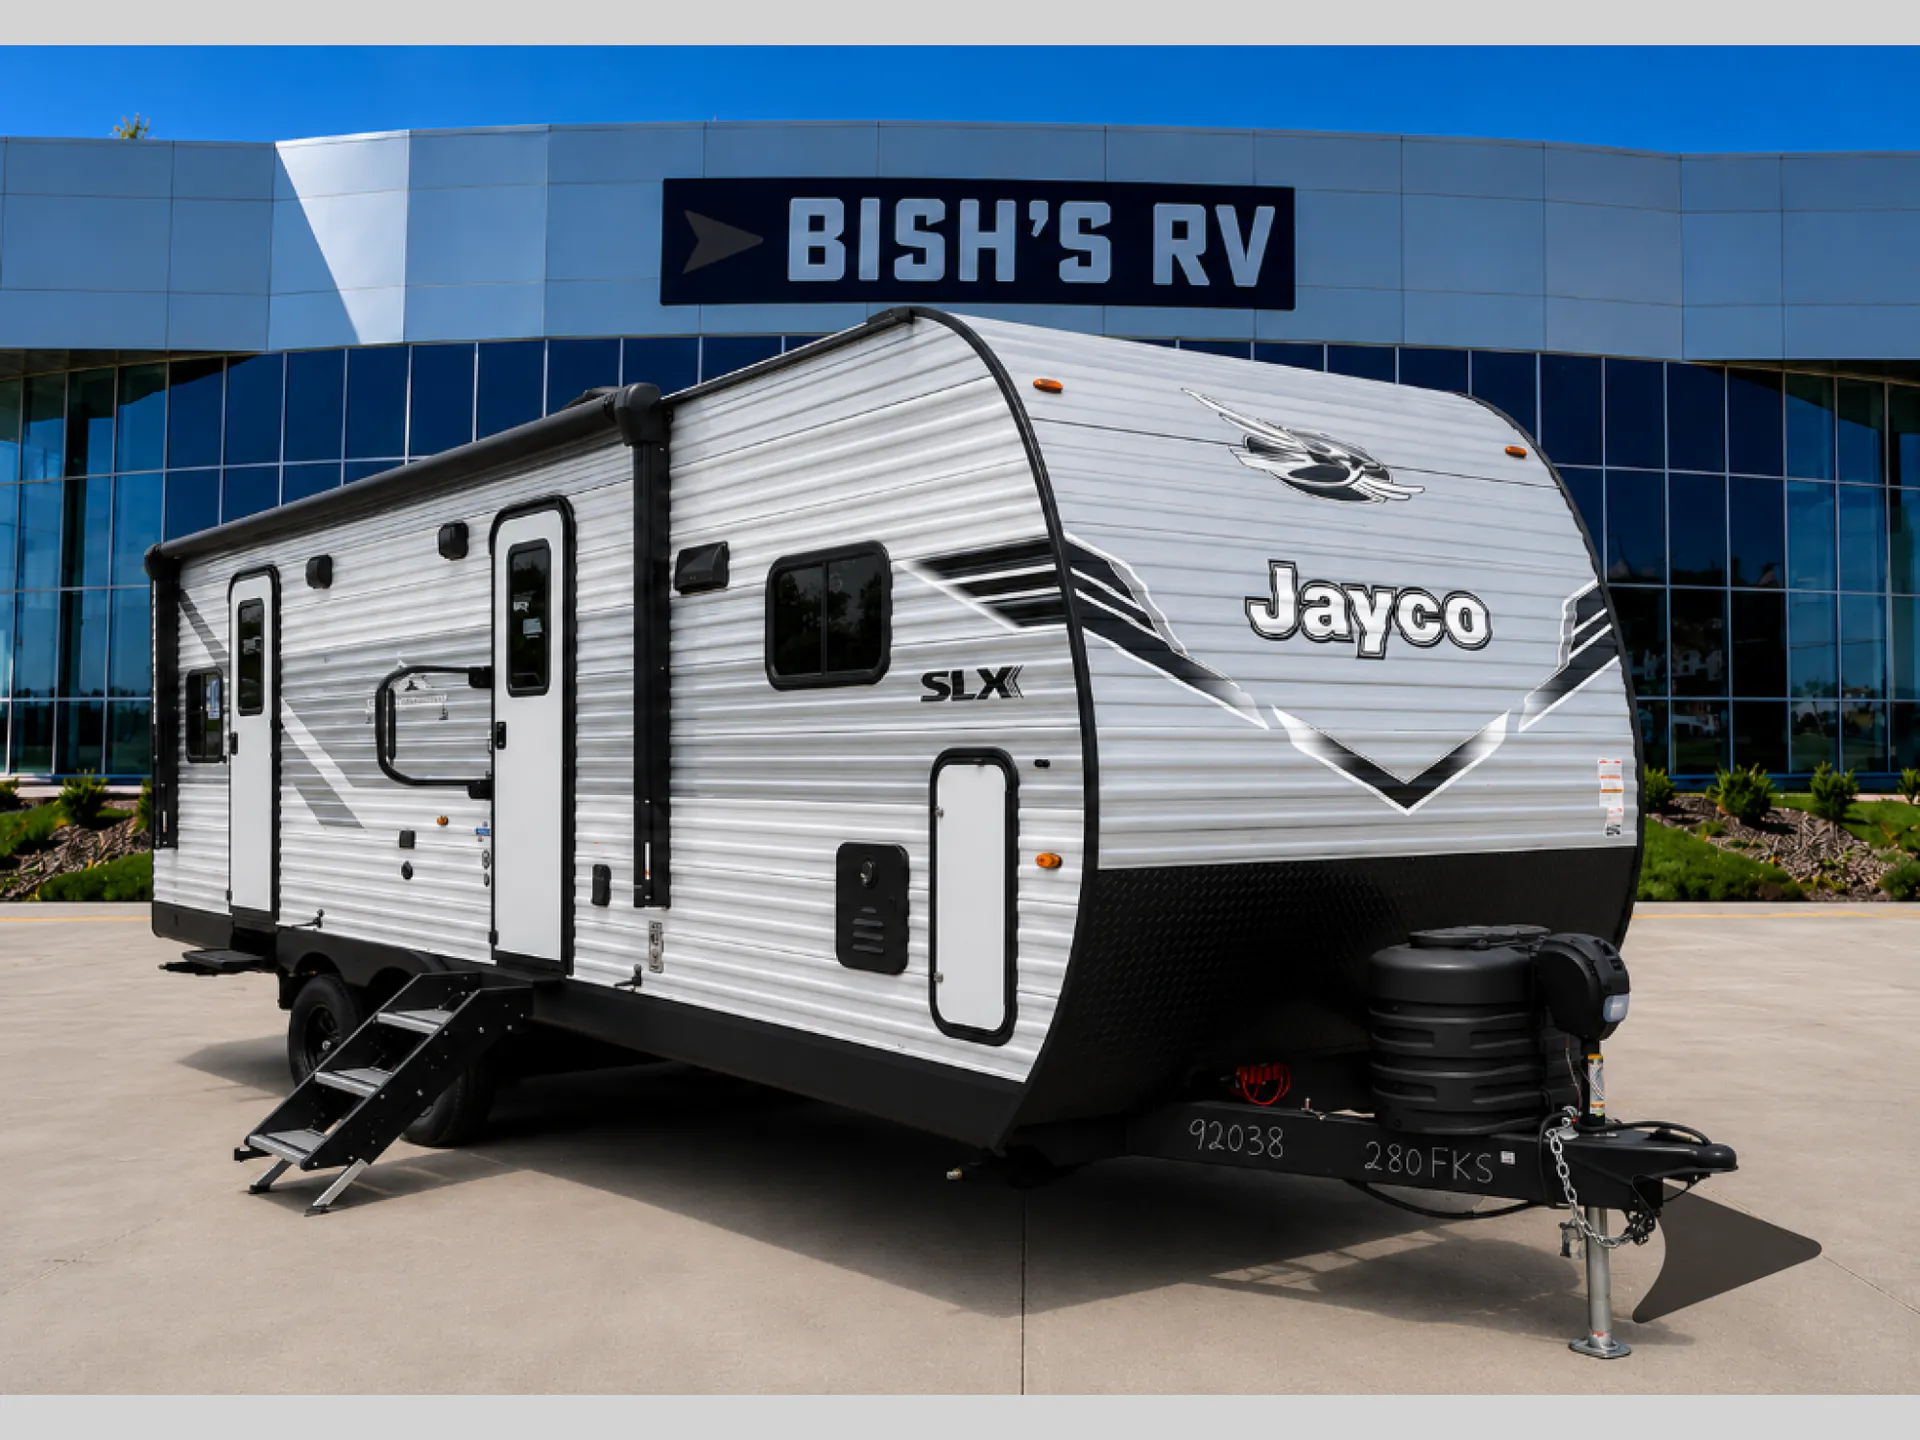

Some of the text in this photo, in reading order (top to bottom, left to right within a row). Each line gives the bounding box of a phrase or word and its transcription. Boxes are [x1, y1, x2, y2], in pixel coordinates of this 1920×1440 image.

[787, 197, 1276, 287] BISH'S RV
[1245, 559, 1493, 660] Jayco
[920, 665, 1024, 702] SLX
[1189, 1118, 1284, 1159] 92038
